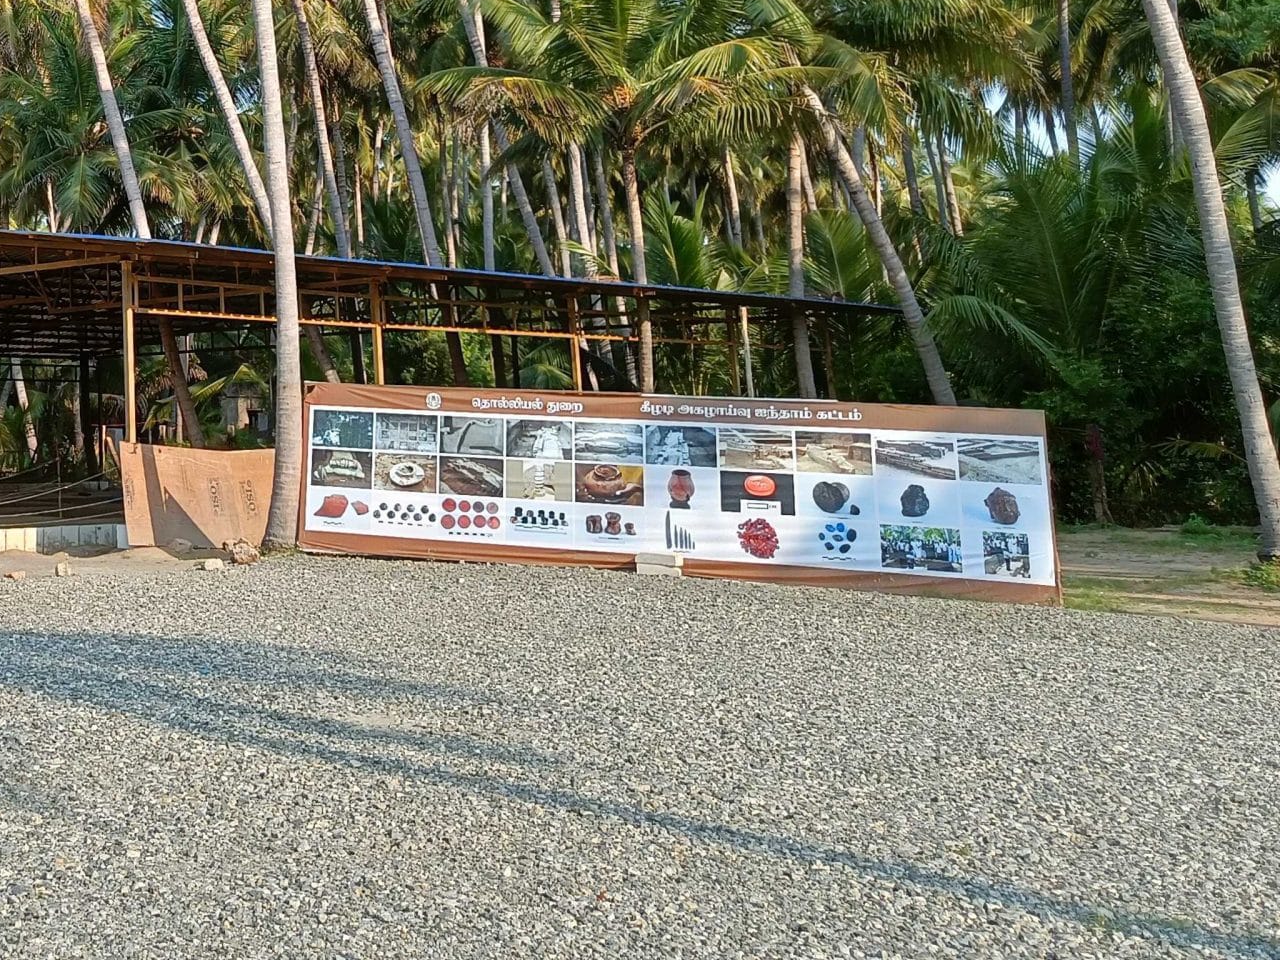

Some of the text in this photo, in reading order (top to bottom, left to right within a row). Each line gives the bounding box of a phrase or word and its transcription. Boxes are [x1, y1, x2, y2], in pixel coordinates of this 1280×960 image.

[472, 396, 583, 413] தொல்லியல் துறை
[639, 400, 862, 421] கீழடி அகழாய்வு ஐந்தாம் கட்டம்
